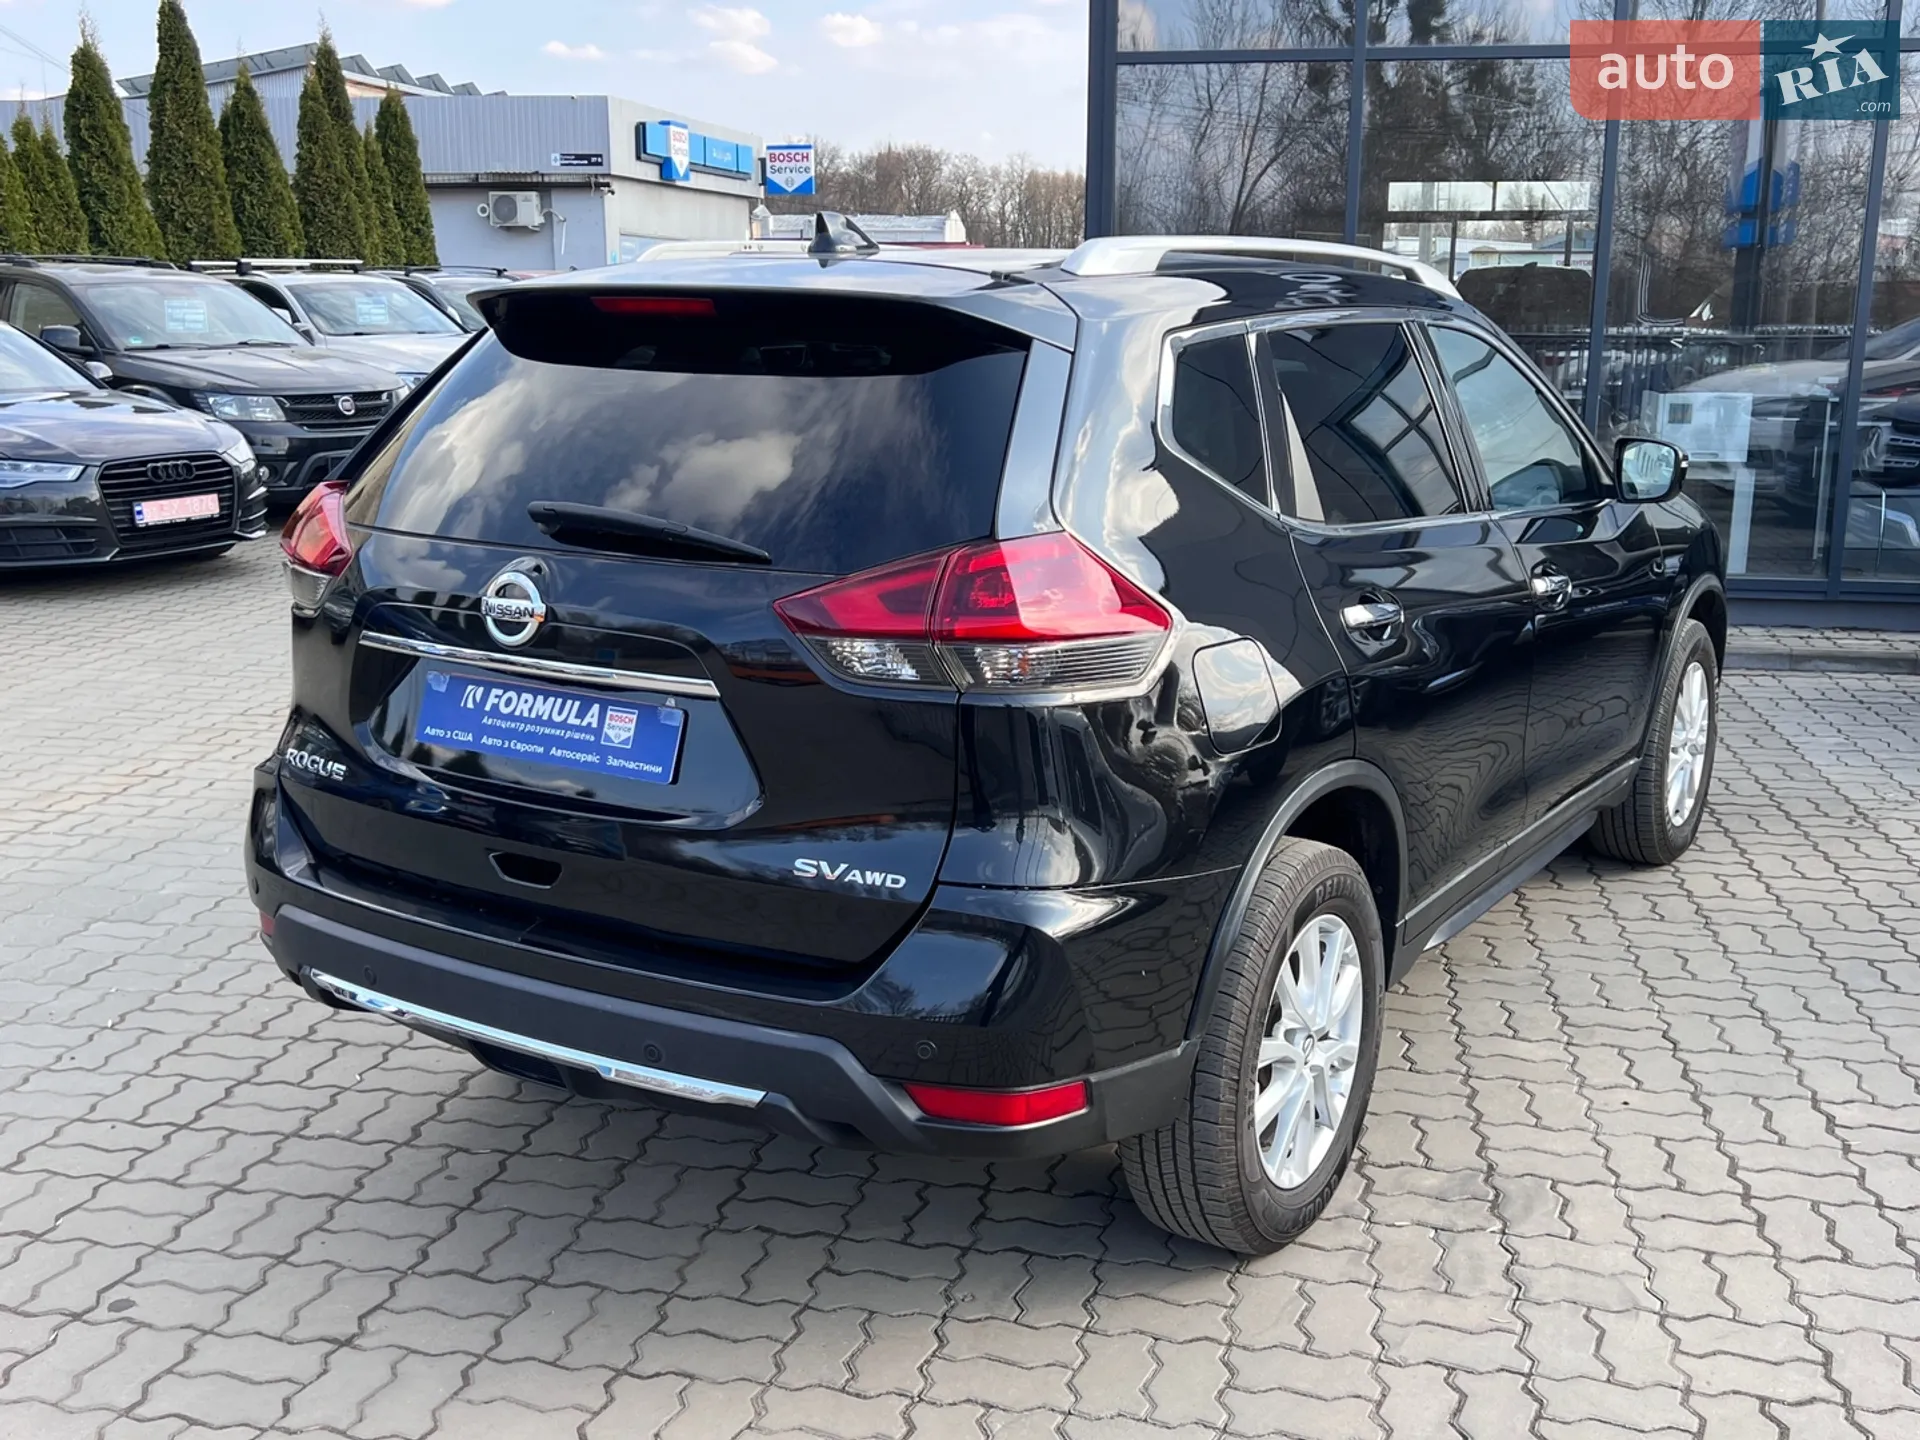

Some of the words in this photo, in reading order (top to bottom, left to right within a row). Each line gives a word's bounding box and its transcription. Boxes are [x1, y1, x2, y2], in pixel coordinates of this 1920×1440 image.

[769, 151, 810, 163] BOSCH
[769, 163, 811, 175] Service
[483, 601, 535, 618] NISSAN
[484, 689, 601, 727] FORMULA
[481, 714, 526, 733] Автоцентр
[608, 712, 635, 725] BOSCH
[424, 725, 445, 737] Авто
[453, 730, 473, 742] США
[606, 723, 632, 735] Service
[481, 734, 502, 748] Авто
[510, 739, 544, 755] Європи
[549, 746, 600, 763] Автосервіс
[287, 748, 346, 781] ROGUE
[606, 755, 662, 774] Запчастини
[793, 858, 849, 880] SV
[844, 869, 907, 889] AWD
